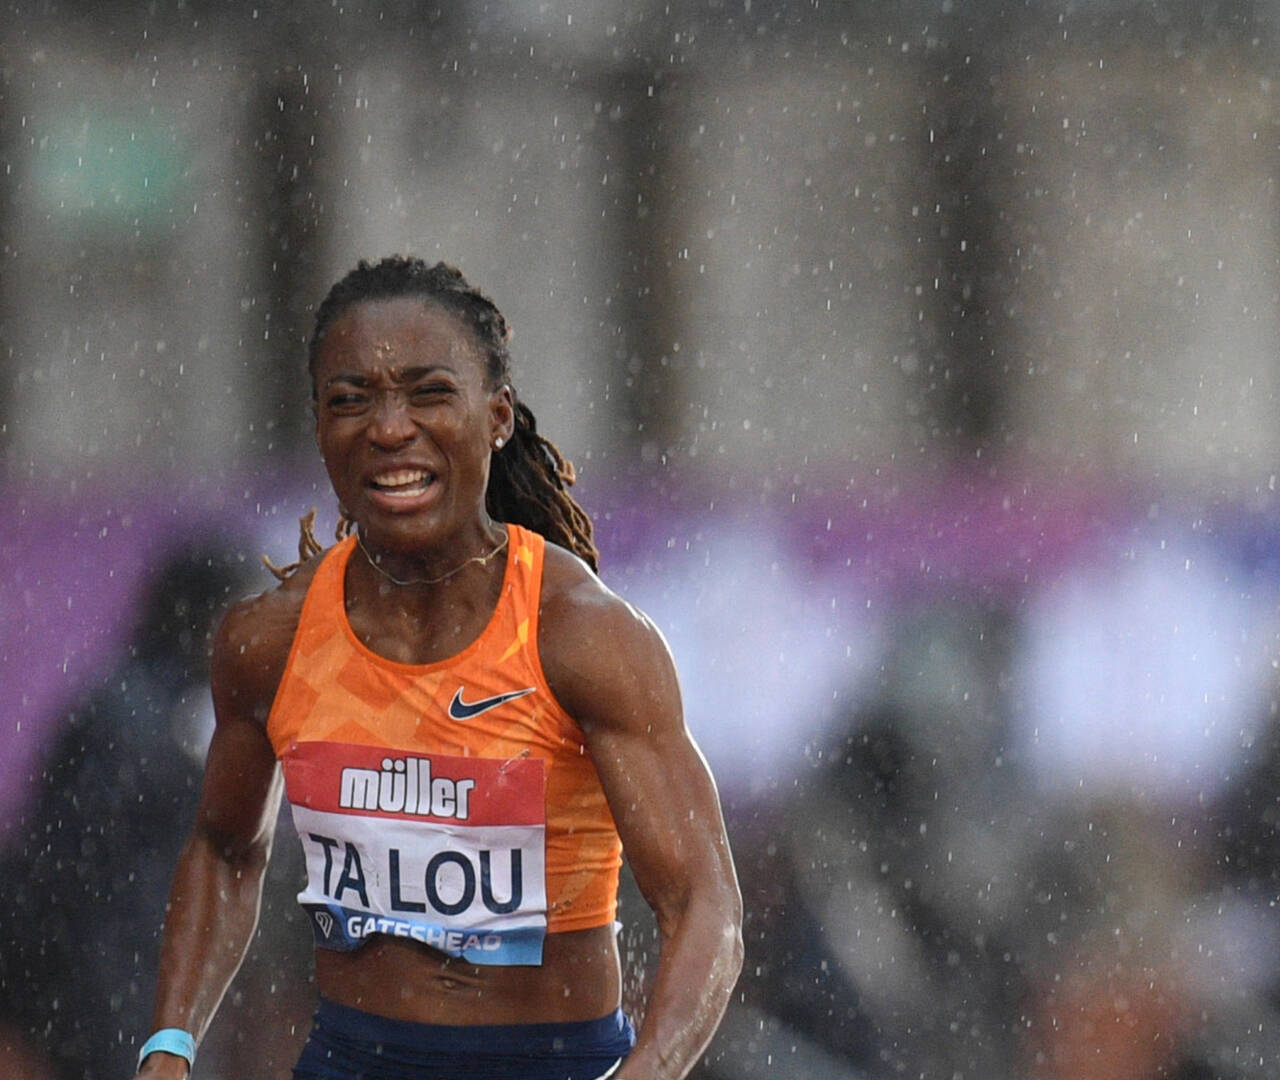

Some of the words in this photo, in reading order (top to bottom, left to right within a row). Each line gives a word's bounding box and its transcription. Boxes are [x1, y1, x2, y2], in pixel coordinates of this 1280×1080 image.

[340, 757, 475, 820] müller
[308, 832, 370, 908] TA
[389, 848, 522, 916] LOU
[347, 916, 502, 951] GATESHEAD
